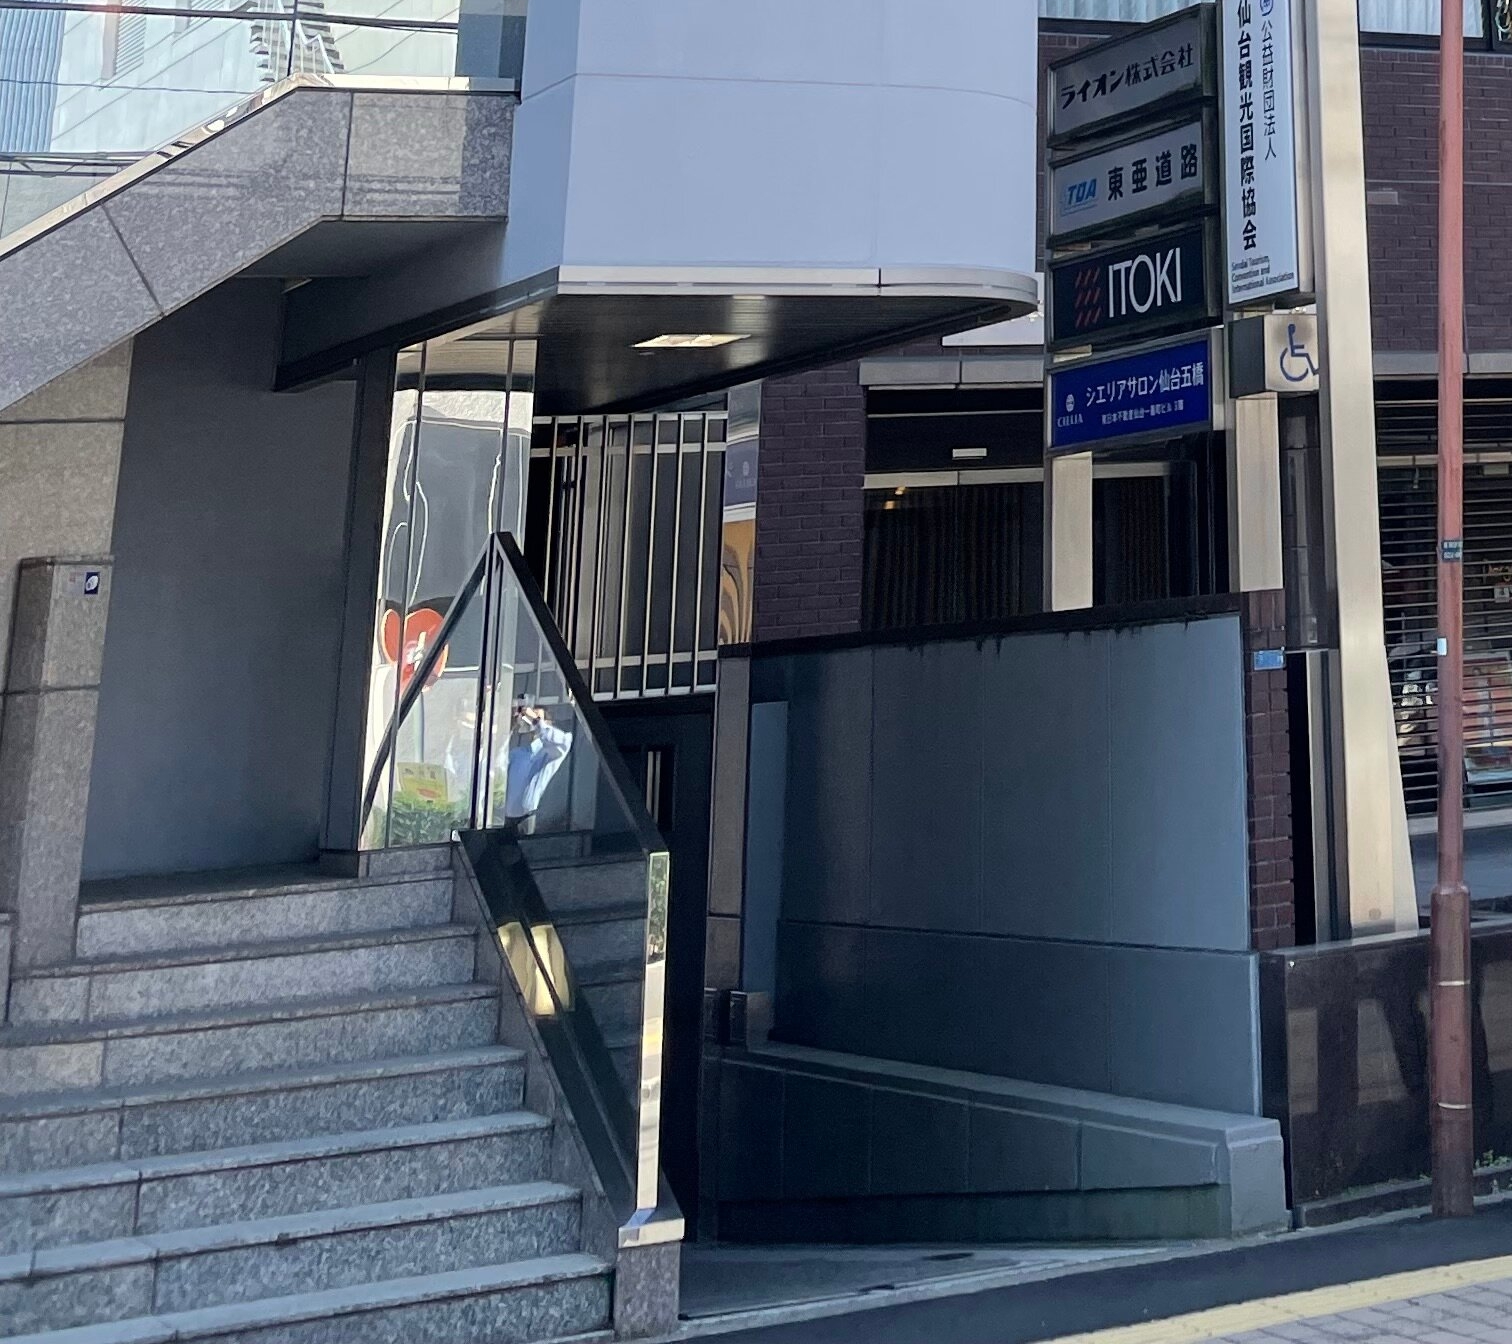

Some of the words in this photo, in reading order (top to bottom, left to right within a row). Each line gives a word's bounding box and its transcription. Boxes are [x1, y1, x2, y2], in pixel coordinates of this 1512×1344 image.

[1060, 42, 1194, 110] ライオン株式会社
[1261, 19, 1277, 161] 公益財団法人
[1107, 143, 1198, 201] 東亜道路
[1108, 247, 1182, 318] ITOKI
[1085, 361, 1205, 408] シエリアサロン仙台五橋
